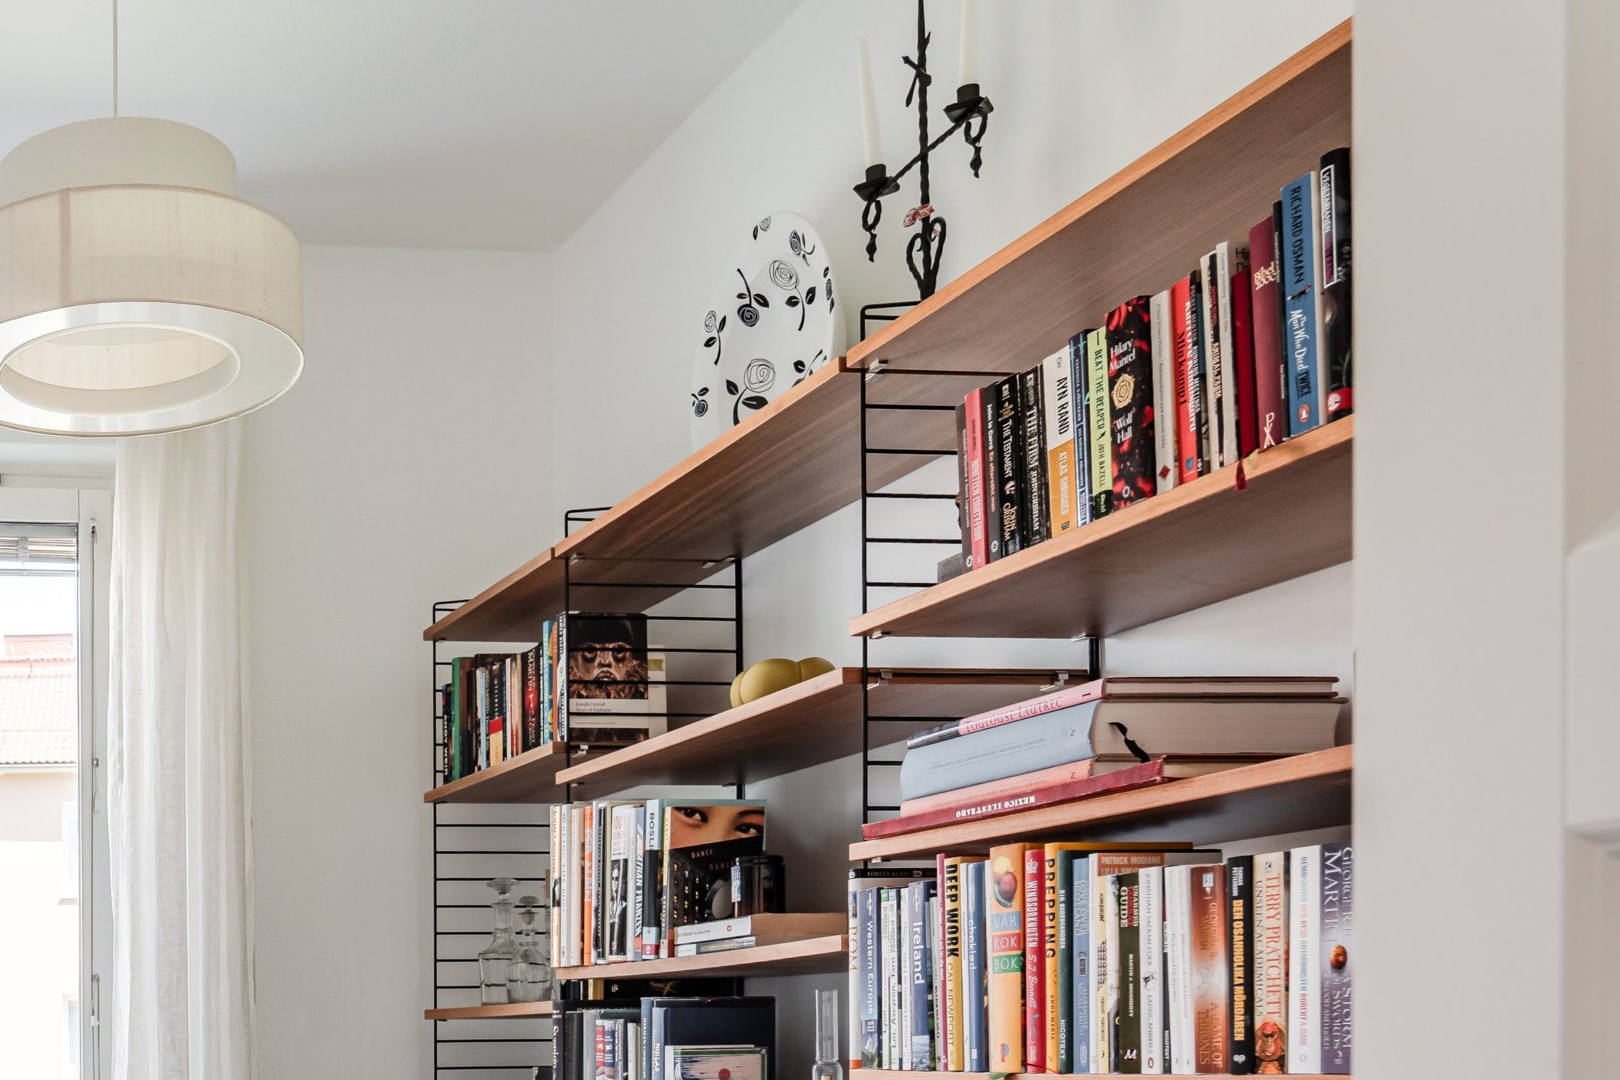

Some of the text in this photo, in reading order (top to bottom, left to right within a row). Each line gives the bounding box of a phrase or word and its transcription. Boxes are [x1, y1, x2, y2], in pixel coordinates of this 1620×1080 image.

[1290, 185, 1305, 286] RICHARD OSMAN
[1109, 348, 1136, 375] Mantel
[1111, 339, 1134, 358] Hilary
[1288, 309, 1311, 398] Man Who Died TWICE
[1056, 377, 1070, 436] AYN RAND
[1094, 349, 1106, 431] BEAT THE REAPER
[986, 404, 994, 421] John
[1027, 406, 1038, 436] THE
[1113, 411, 1134, 430] Wolf
[1028, 436, 1040, 469] FIRM
[1117, 425, 1133, 444] Hall
[1003, 440, 1014, 478] TESTAMENT
[1058, 451, 1069, 474] ATLAS
[1031, 492, 1041, 531] GRISHAM
[1017, 696, 1063, 719] LAUTREC
[1002, 795, 1036, 809] MEXICO
[691, 849, 714, 859] DANCE
[946, 864, 960, 904] DEEP
[634, 890, 644, 937] FRANZEN
[1045, 859, 1057, 960] PREPPING
[1120, 887, 1129, 929] GUIDE
[946, 907, 960, 959] WORK
[968, 919, 978, 971] choklad
[992, 936, 1019, 949] KOK
[1026, 880, 1039, 1009] WINDSORKNUTEN Bennett
[1264, 873, 1283, 1019] TERRY PRATCHETT
[866, 920, 876, 1016] Western Europe
[912, 921, 926, 985] Ireland
[992, 957, 1019, 970] BOK
[1232, 899, 1247, 1041] DEN OSANNOLIKA MÖRDAREN
[653, 1042, 661, 1073] NIKLAS
